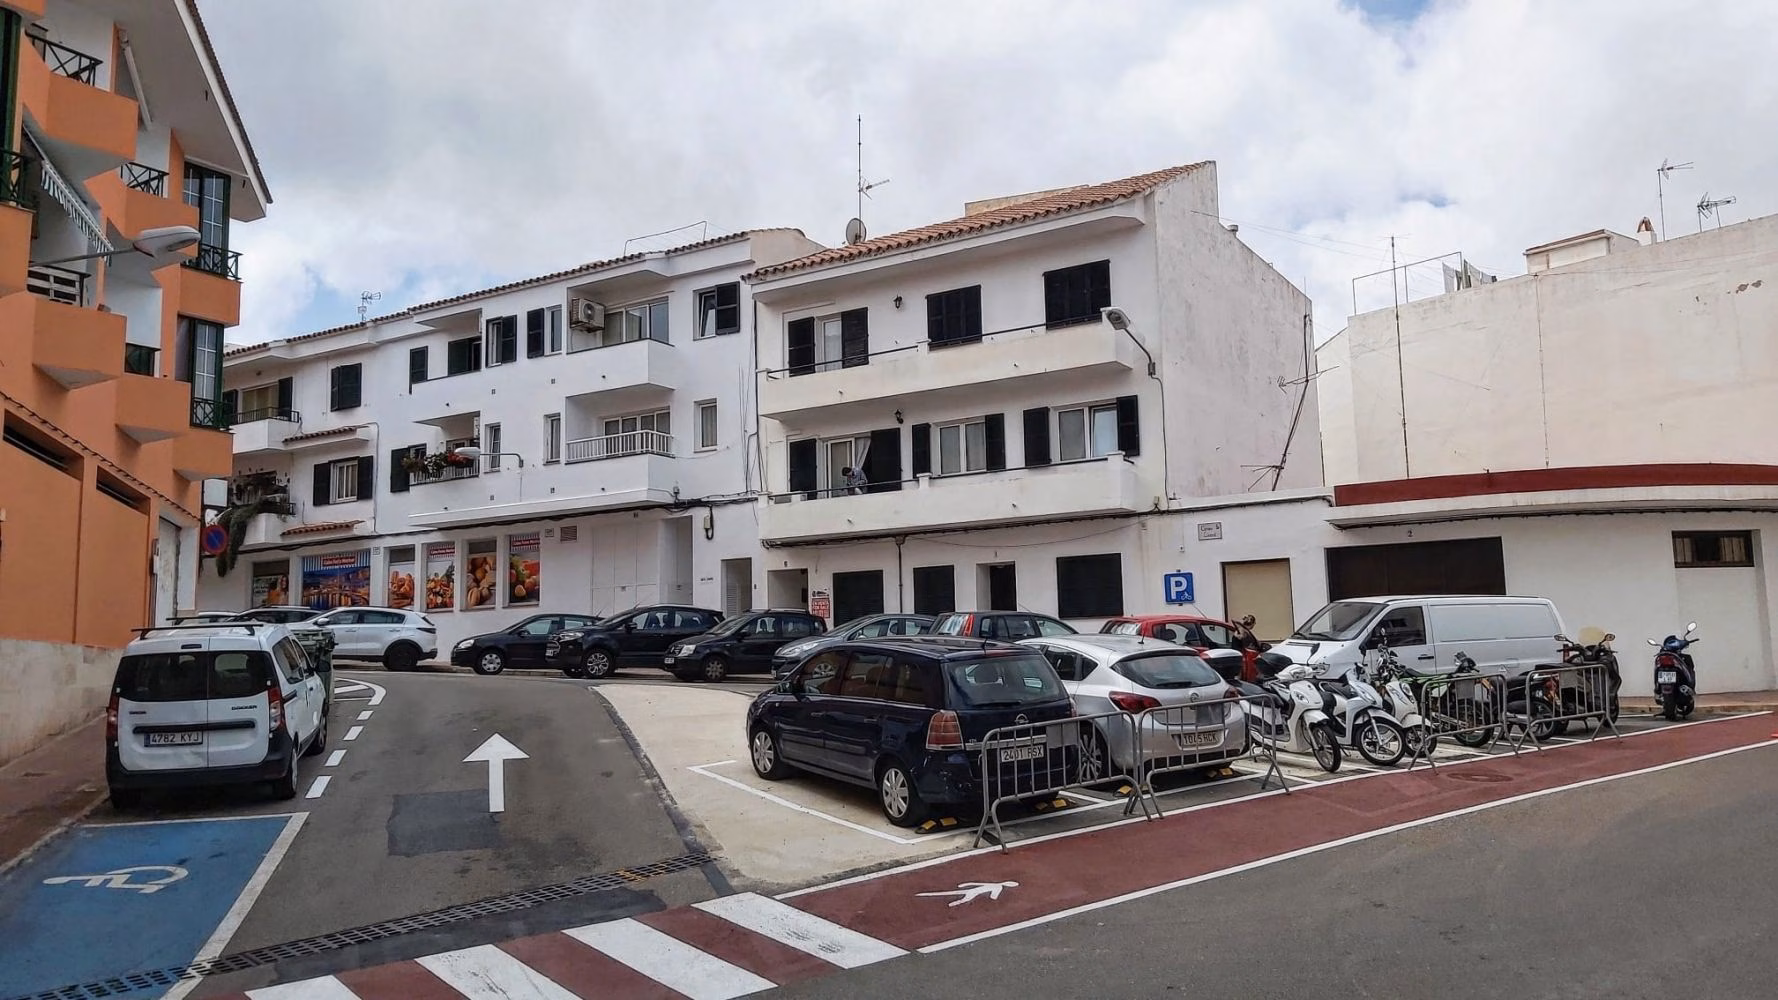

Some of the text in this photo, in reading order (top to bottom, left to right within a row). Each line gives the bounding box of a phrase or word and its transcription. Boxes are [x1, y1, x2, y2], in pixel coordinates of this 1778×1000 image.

[1407, 530, 1414, 538] 2
[1170, 576, 1188, 600] P
[151, 732, 200, 743] 4782 KYJ
